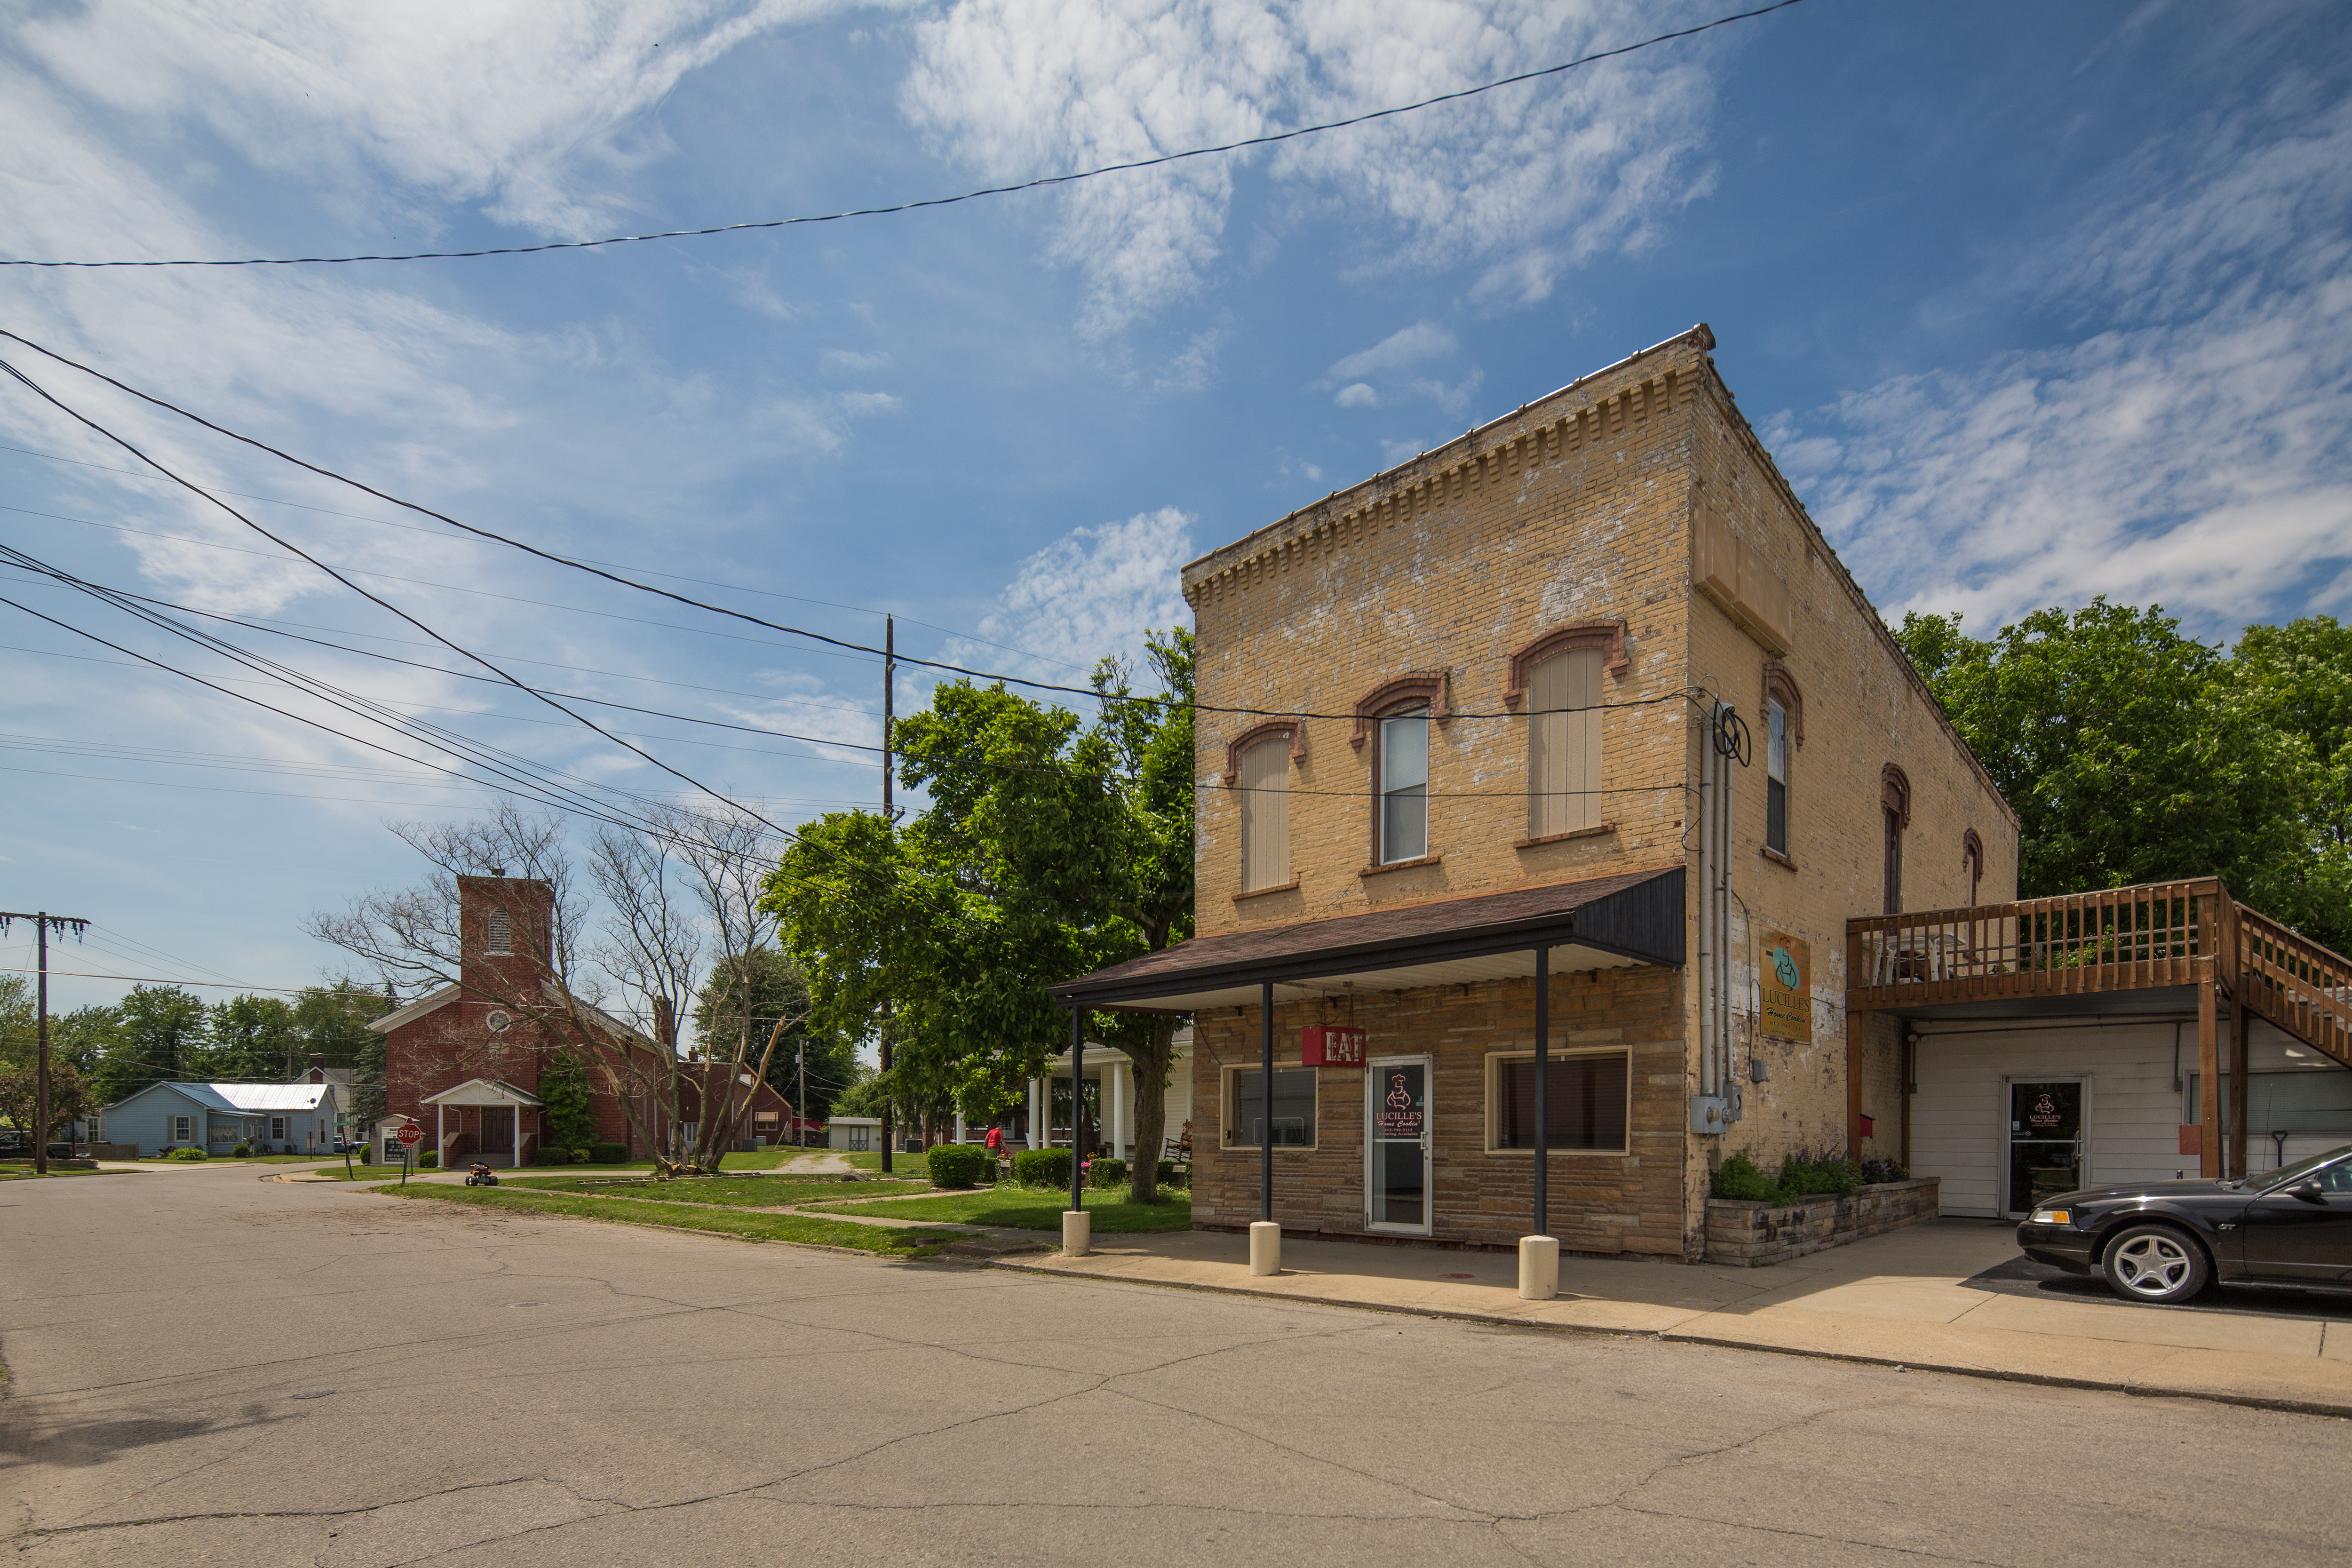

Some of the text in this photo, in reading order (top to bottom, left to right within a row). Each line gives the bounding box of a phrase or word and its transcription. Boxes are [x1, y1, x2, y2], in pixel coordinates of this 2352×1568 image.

[1762, 987, 1810, 1013] LUCILLE'S
[1766, 1007, 1809, 1024] Home Cookin'
[1765, 1027, 1786, 1036] Catering
[1326, 1032, 1364, 1062] EAT
[398, 1130, 420, 1138] STOP
